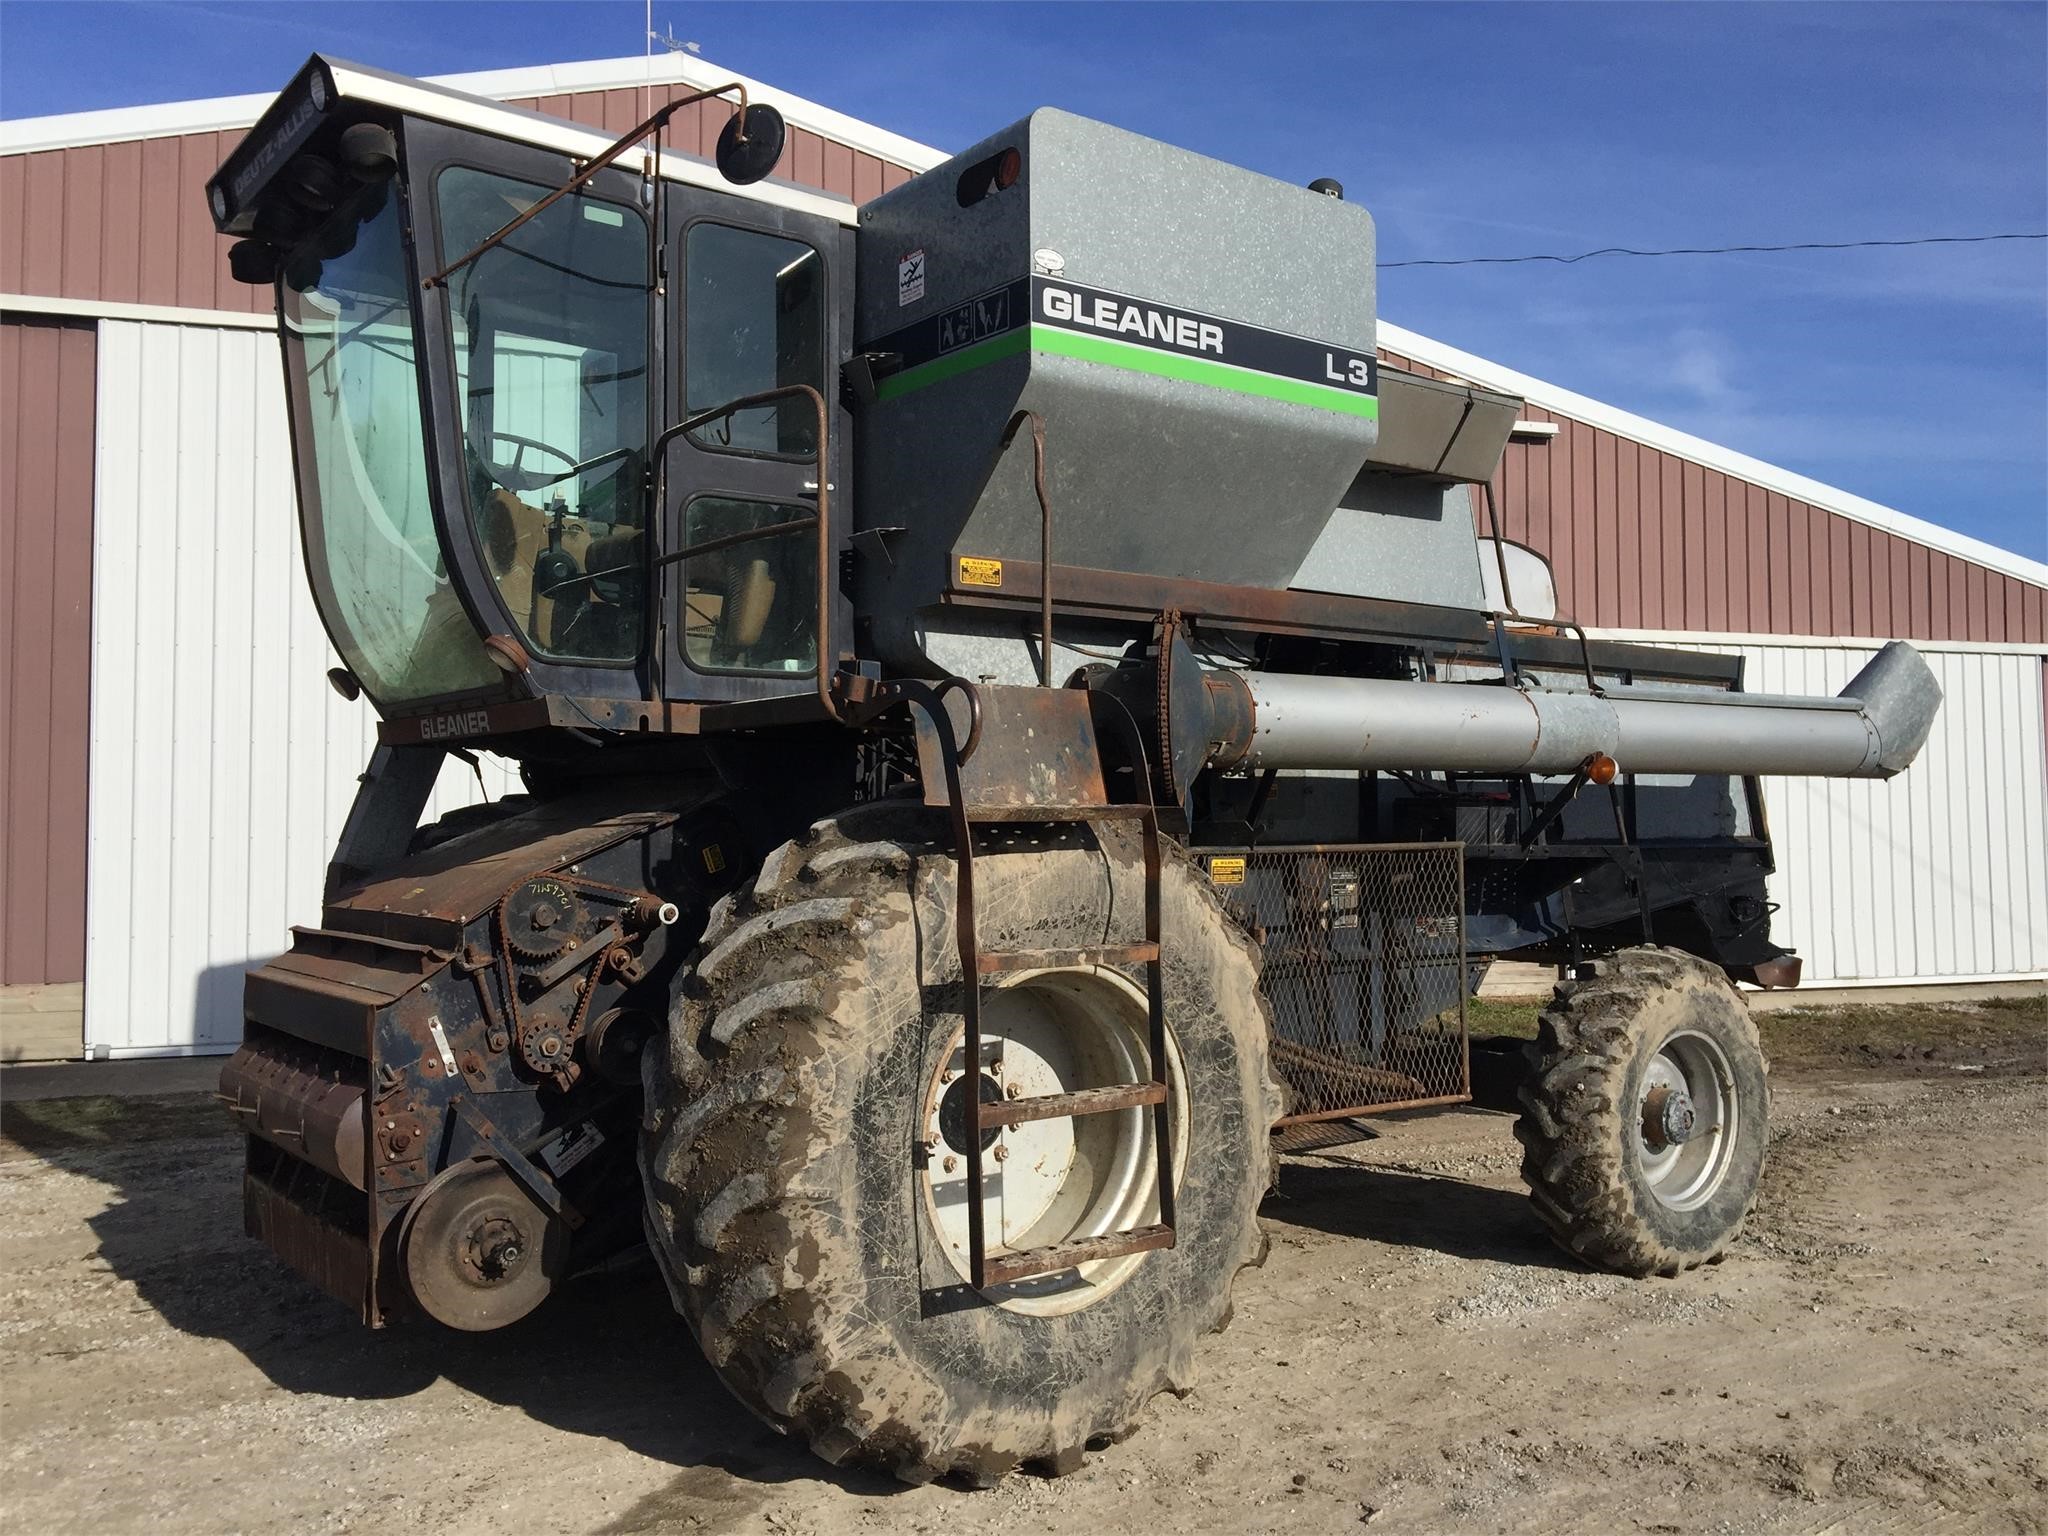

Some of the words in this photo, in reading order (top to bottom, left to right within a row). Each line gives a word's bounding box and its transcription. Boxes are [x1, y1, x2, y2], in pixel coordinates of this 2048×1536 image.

[1042, 287, 1224, 354] GLEANER
[1326, 352, 1369, 387] L3
[420, 711, 490, 740] GLEANER
